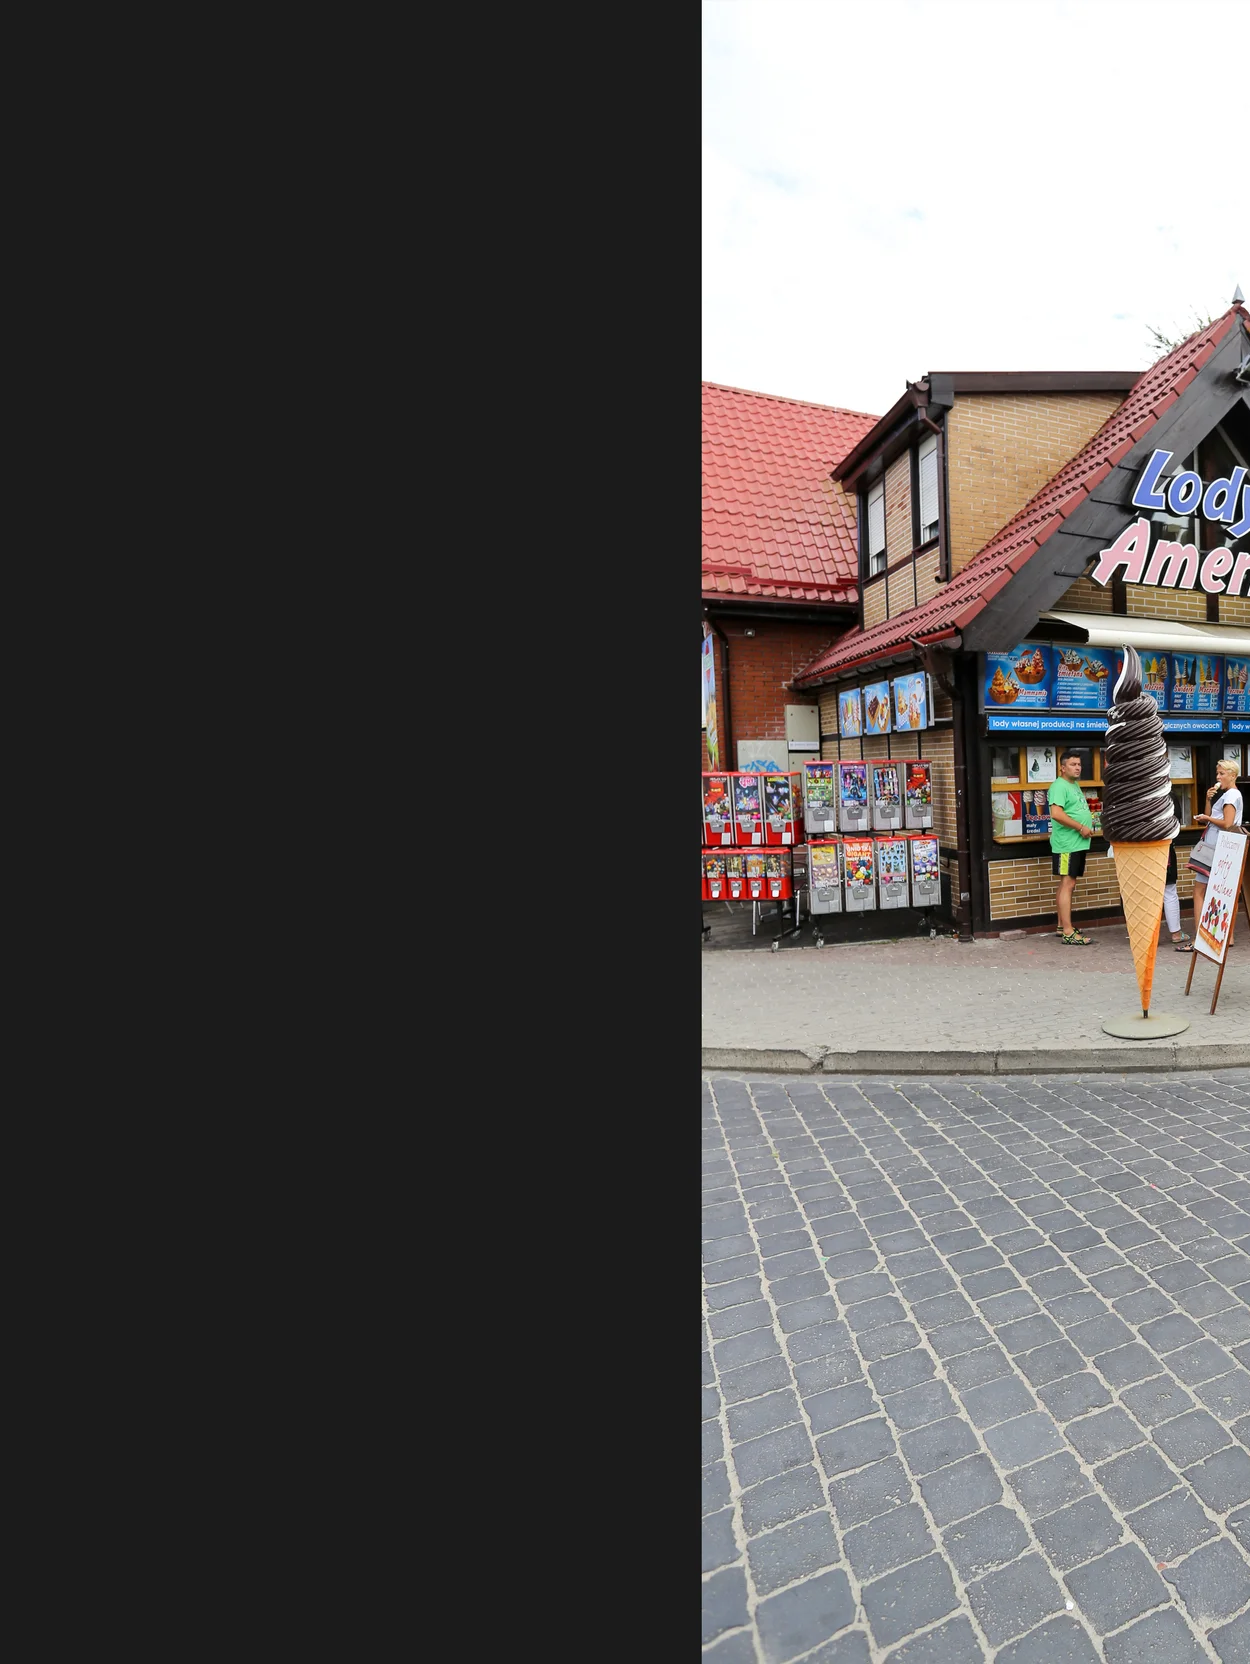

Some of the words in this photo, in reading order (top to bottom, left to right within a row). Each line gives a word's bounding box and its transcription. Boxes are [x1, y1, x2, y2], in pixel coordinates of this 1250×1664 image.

[992, 720, 1010, 728] lody
[1011, 720, 1039, 729] własnej
[1041, 721, 1075, 730] produkcji
[1086, 720, 1110, 728] śmieta
[1164, 722, 1191, 730] gicznych
[1231, 723, 1244, 731] lody
[1025, 813, 1051, 822] Tęczow
